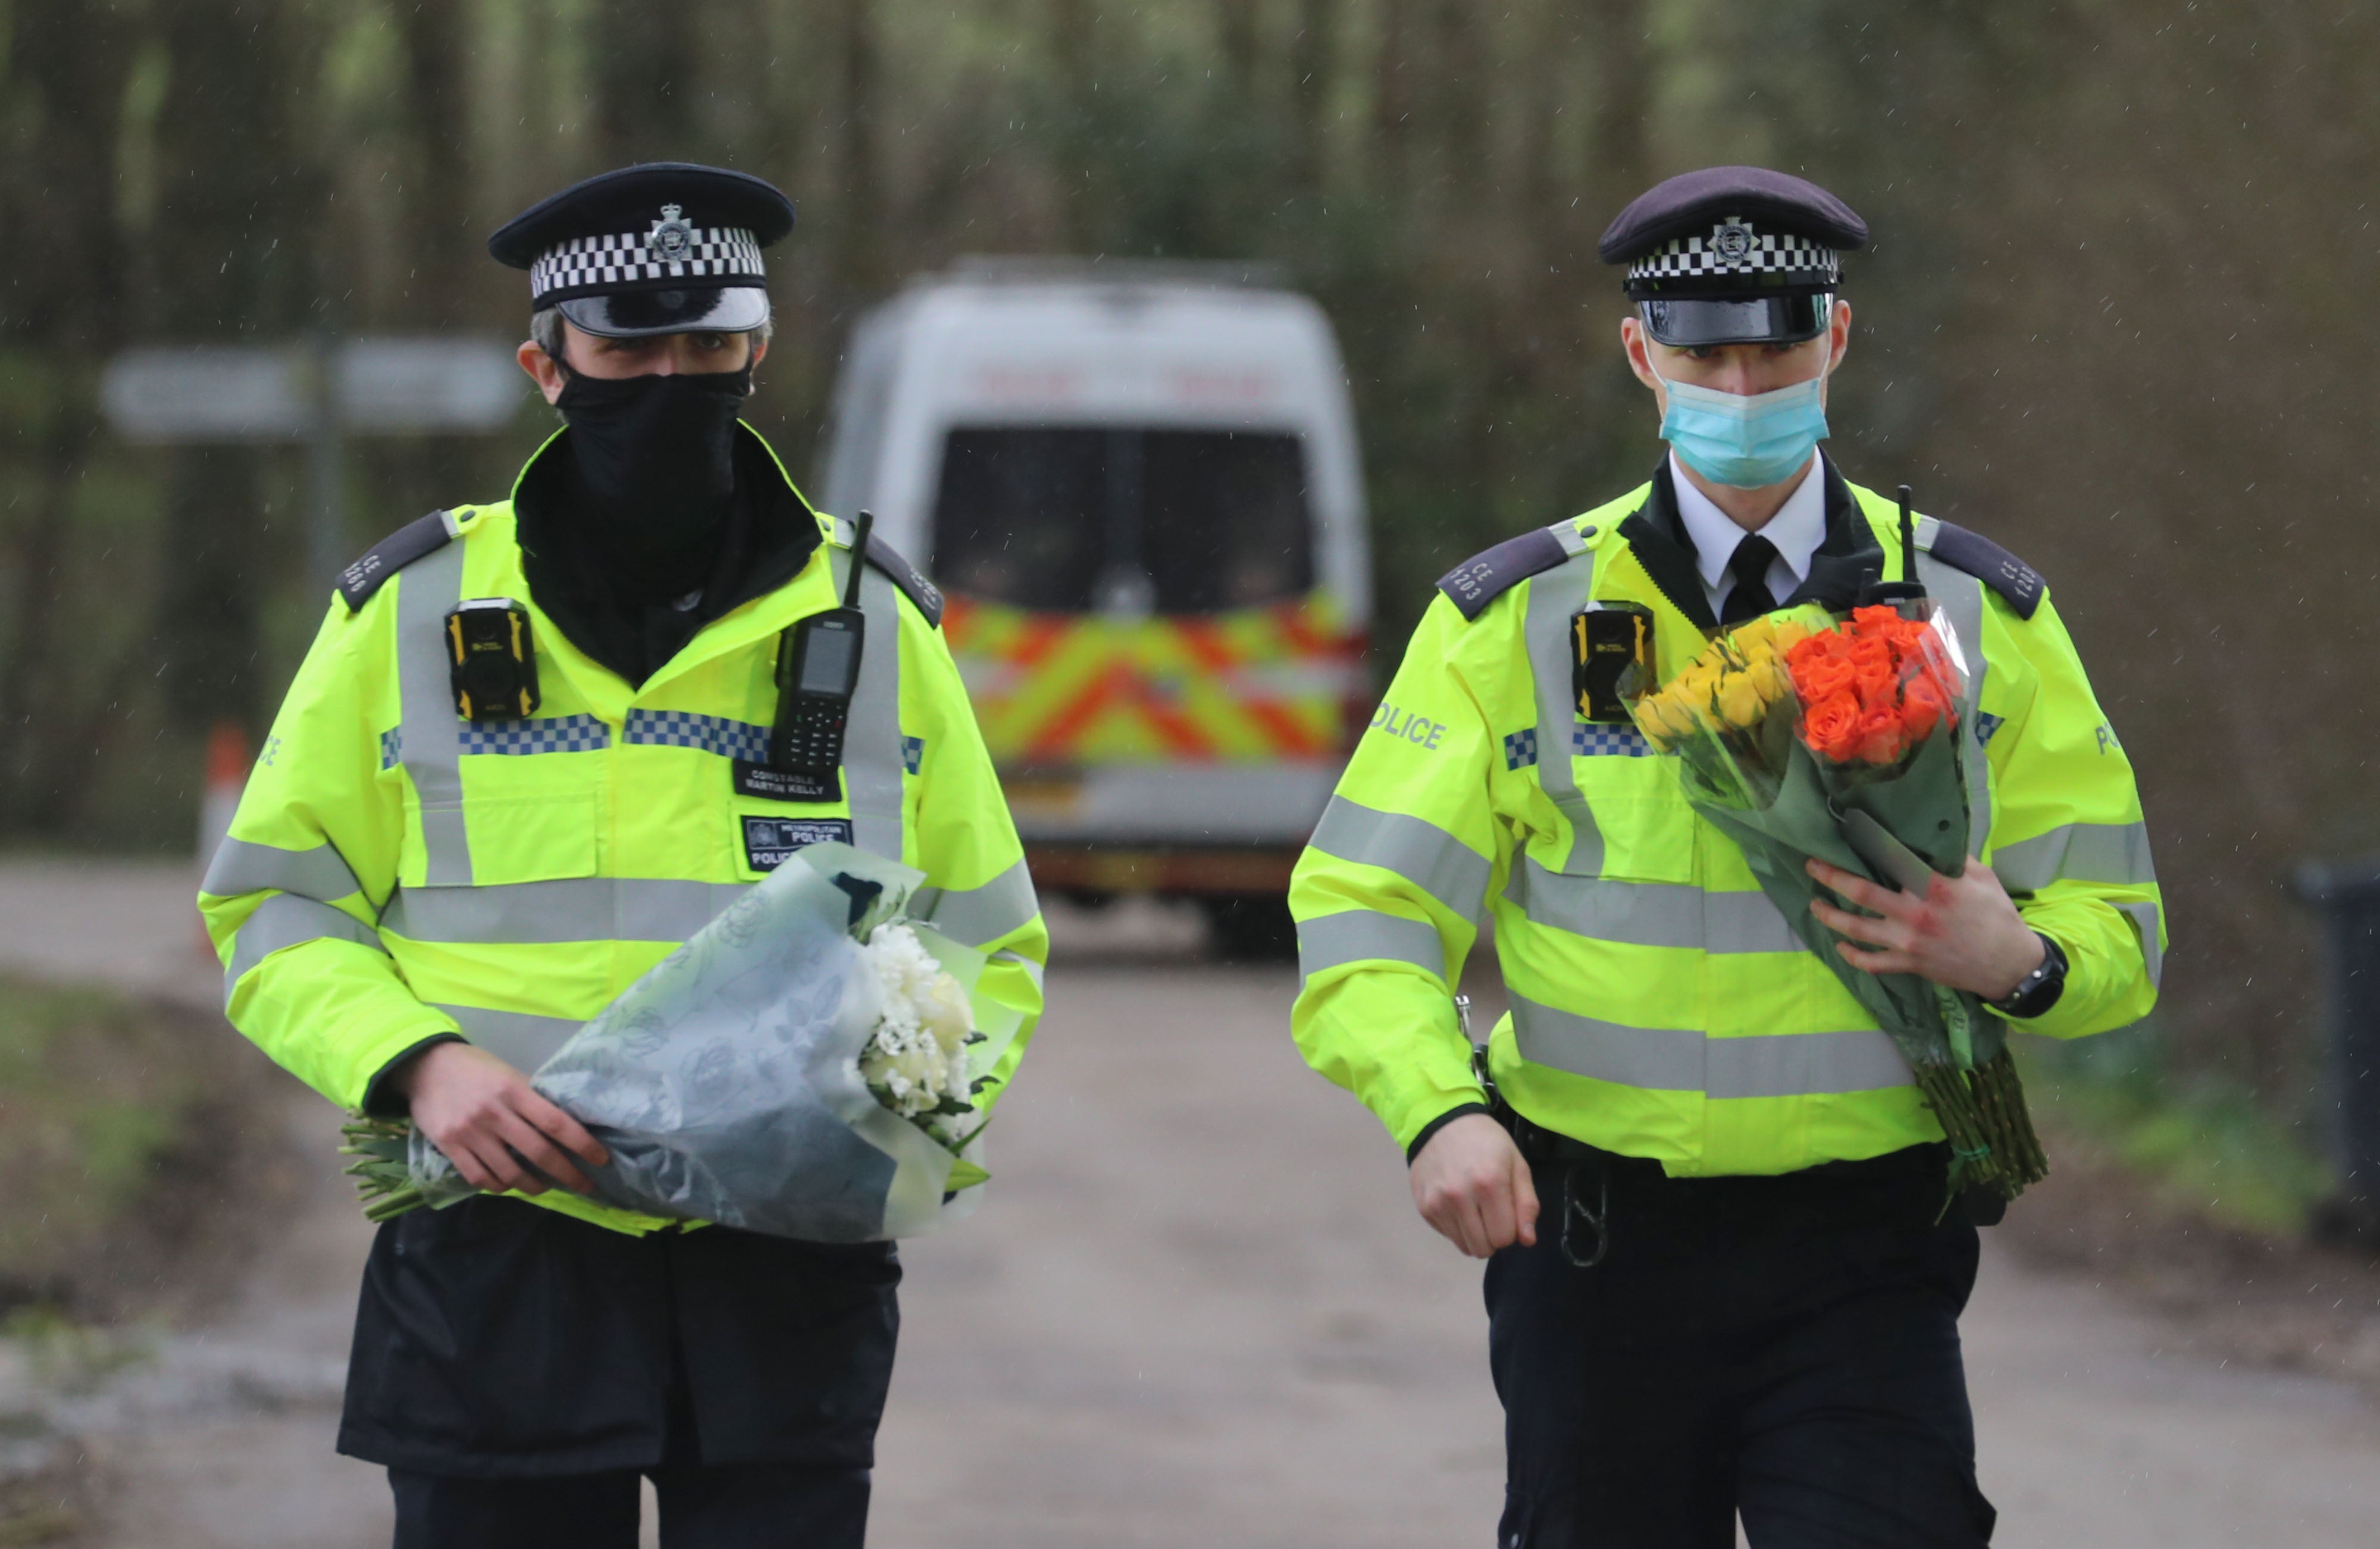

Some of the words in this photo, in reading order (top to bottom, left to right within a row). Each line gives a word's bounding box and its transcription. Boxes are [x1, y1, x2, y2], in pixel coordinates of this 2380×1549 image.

[362, 554, 381, 573] CE
[2000, 562, 2018, 579] CE
[1471, 563, 1493, 582] CE
[1450, 568, 1482, 600] 1203
[751, 770, 815, 785] CONSTABLE
[746, 778, 785, 793] MARTIN
[788, 785, 824, 795] KELLY
[791, 832, 834, 843] POLICE
